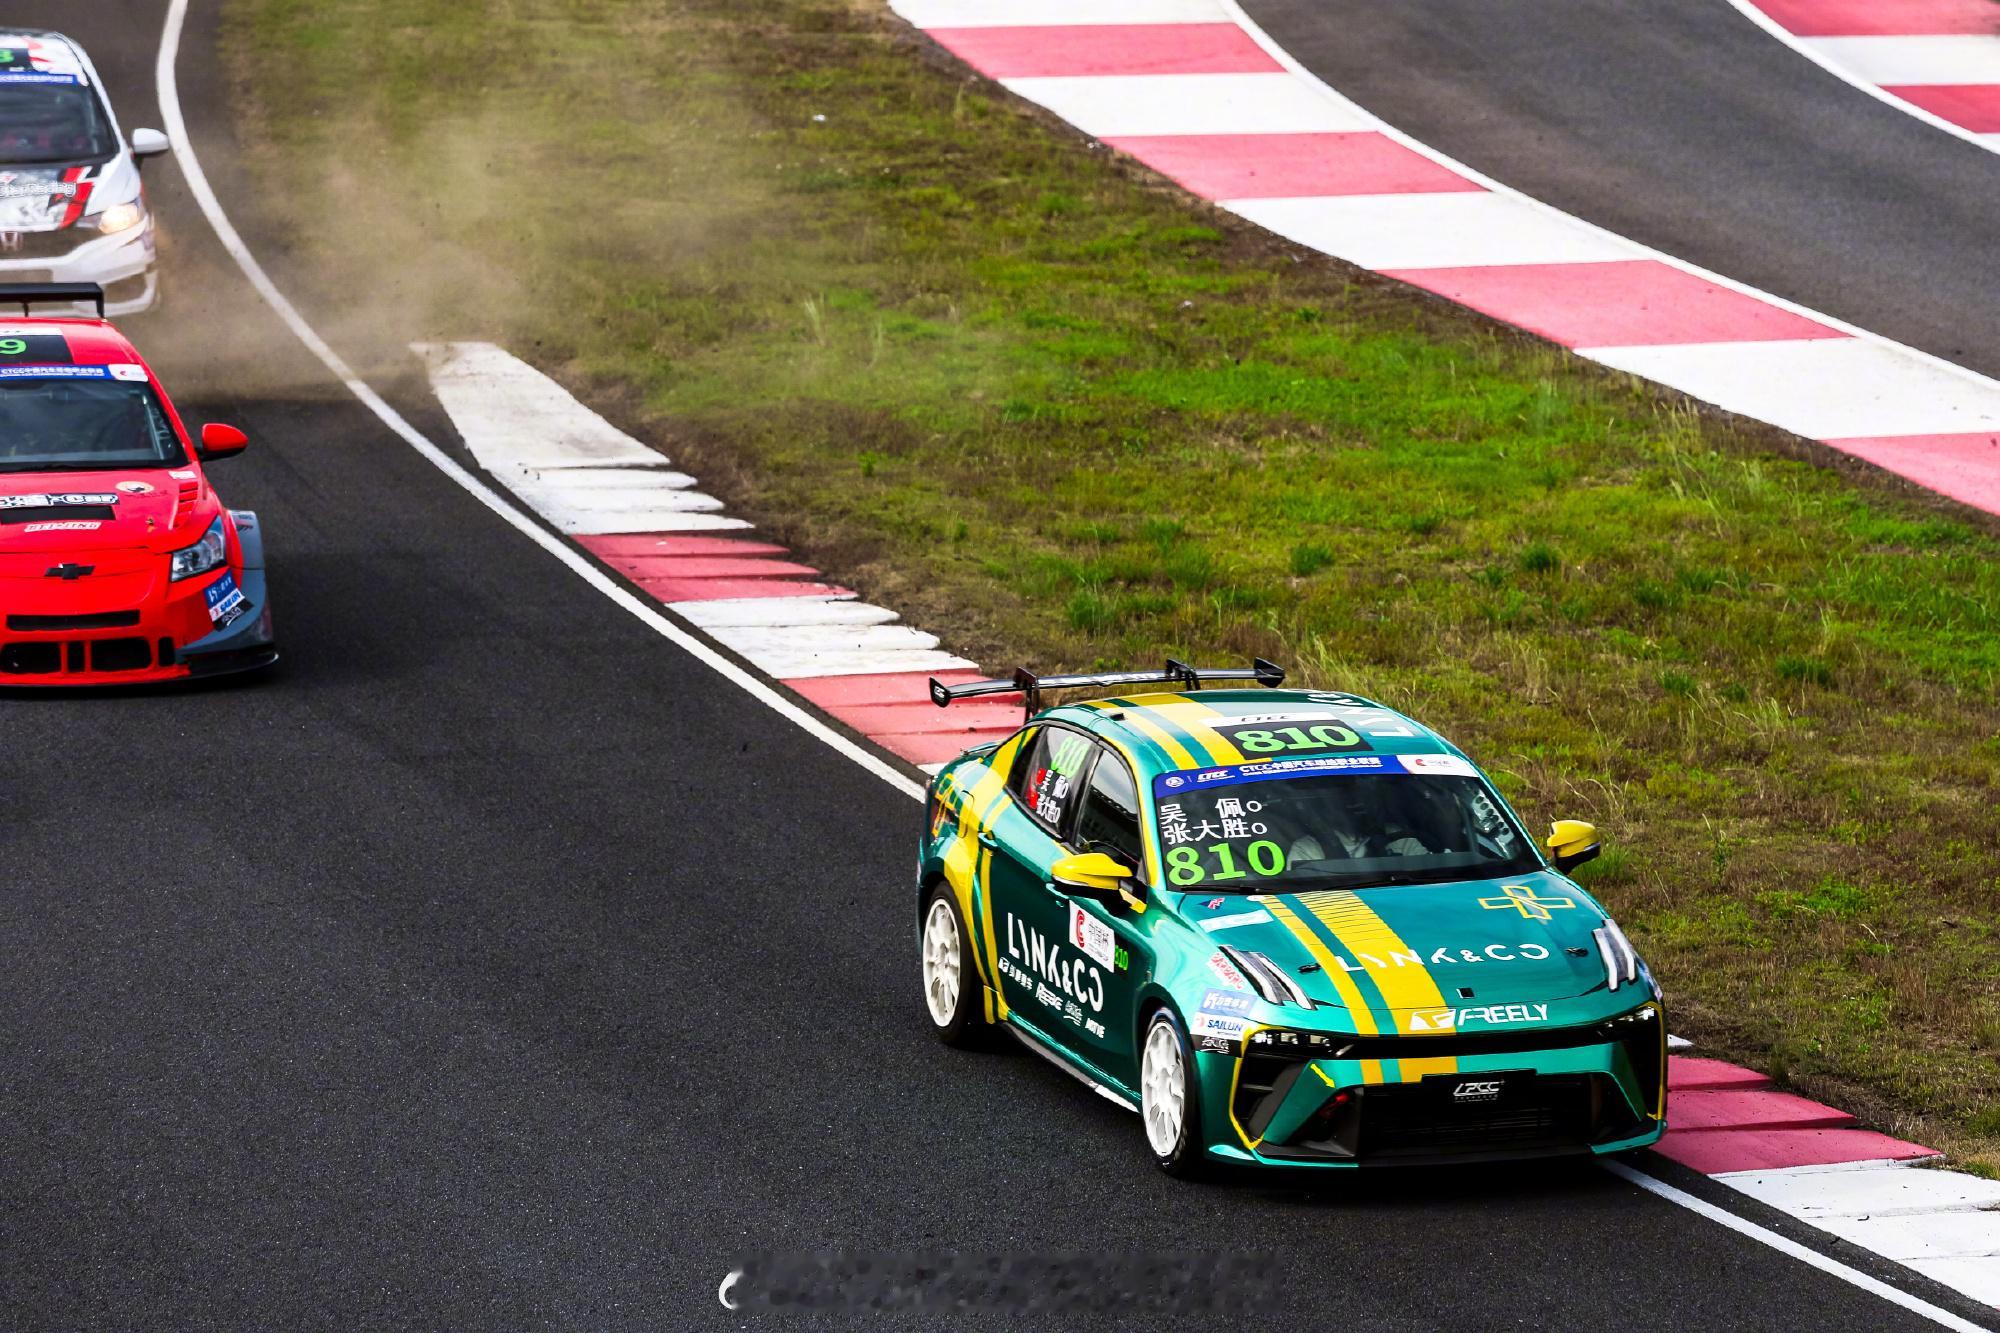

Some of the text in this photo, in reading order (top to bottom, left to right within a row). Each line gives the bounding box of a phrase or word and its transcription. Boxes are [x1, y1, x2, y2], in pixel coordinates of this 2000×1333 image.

[0, 339, 27, 354] 9
[1233, 725, 1361, 752] 810
[1159, 803, 1187, 825] 吴
[1166, 839, 1286, 886] 810
[1207, 1020, 1243, 1032] SAILUN
